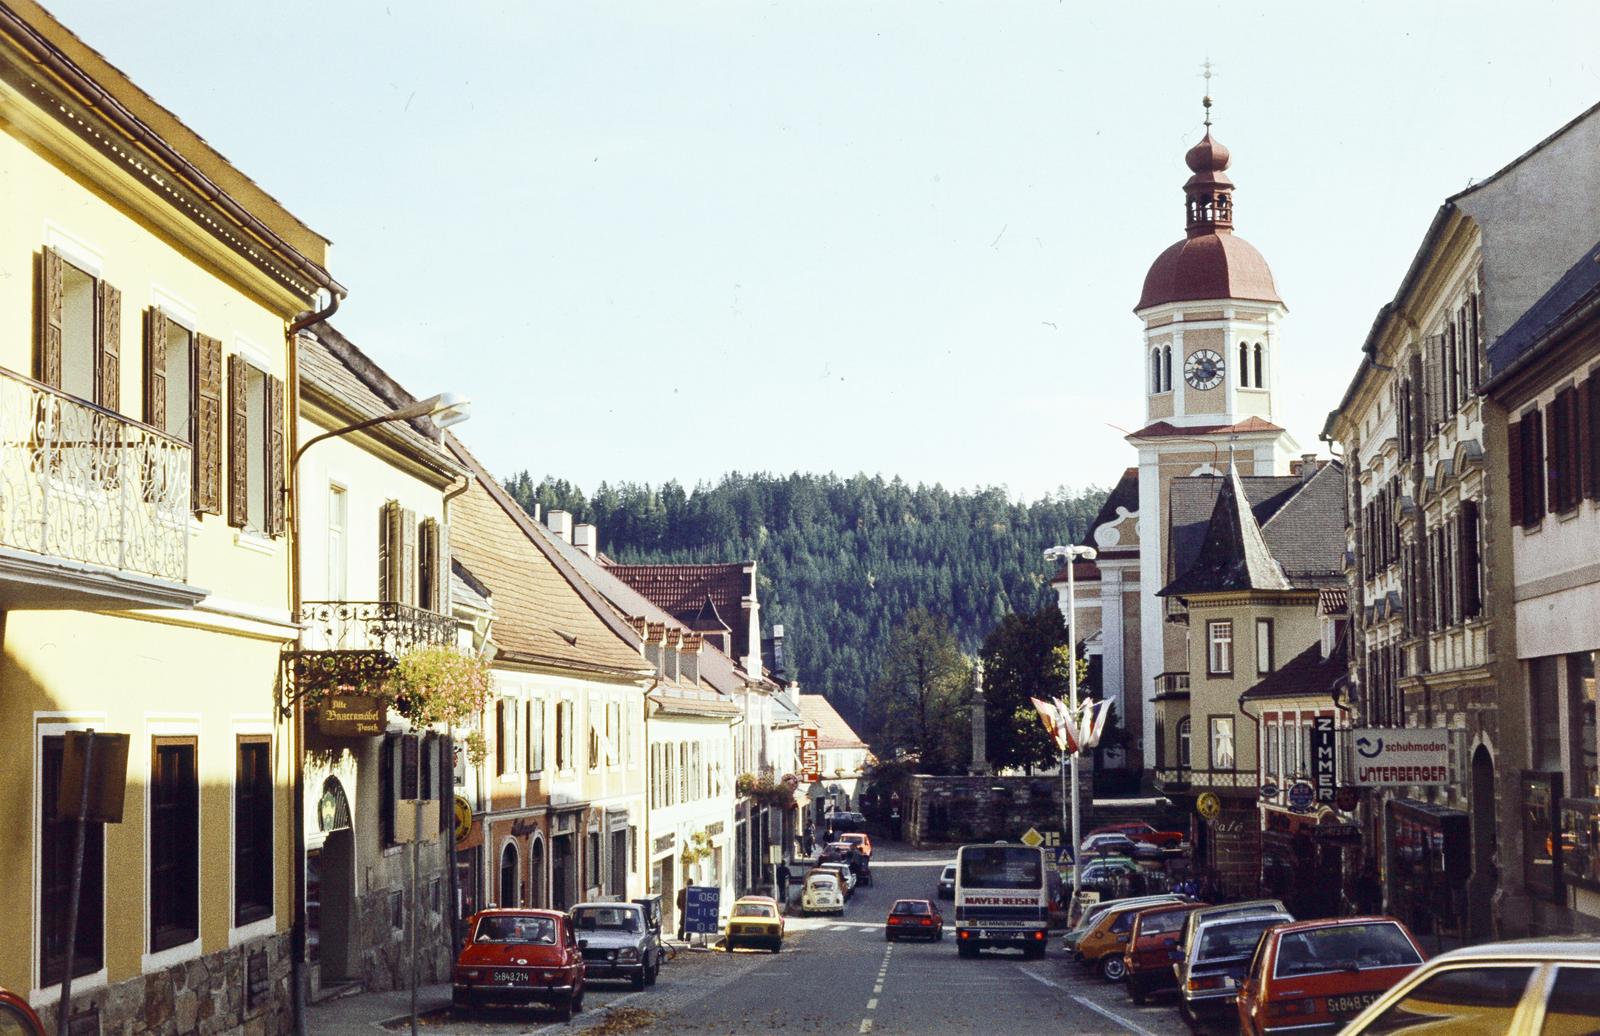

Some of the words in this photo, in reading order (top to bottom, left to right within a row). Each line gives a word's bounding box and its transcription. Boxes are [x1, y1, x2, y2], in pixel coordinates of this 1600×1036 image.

[1385, 742, 1447, 752] schuhmoden
[1318, 719, 1333, 800] ZIMMER
[1359, 766, 1446, 781] UNTERBERGER
[965, 897, 1039, 905] MAYER-REISEN
